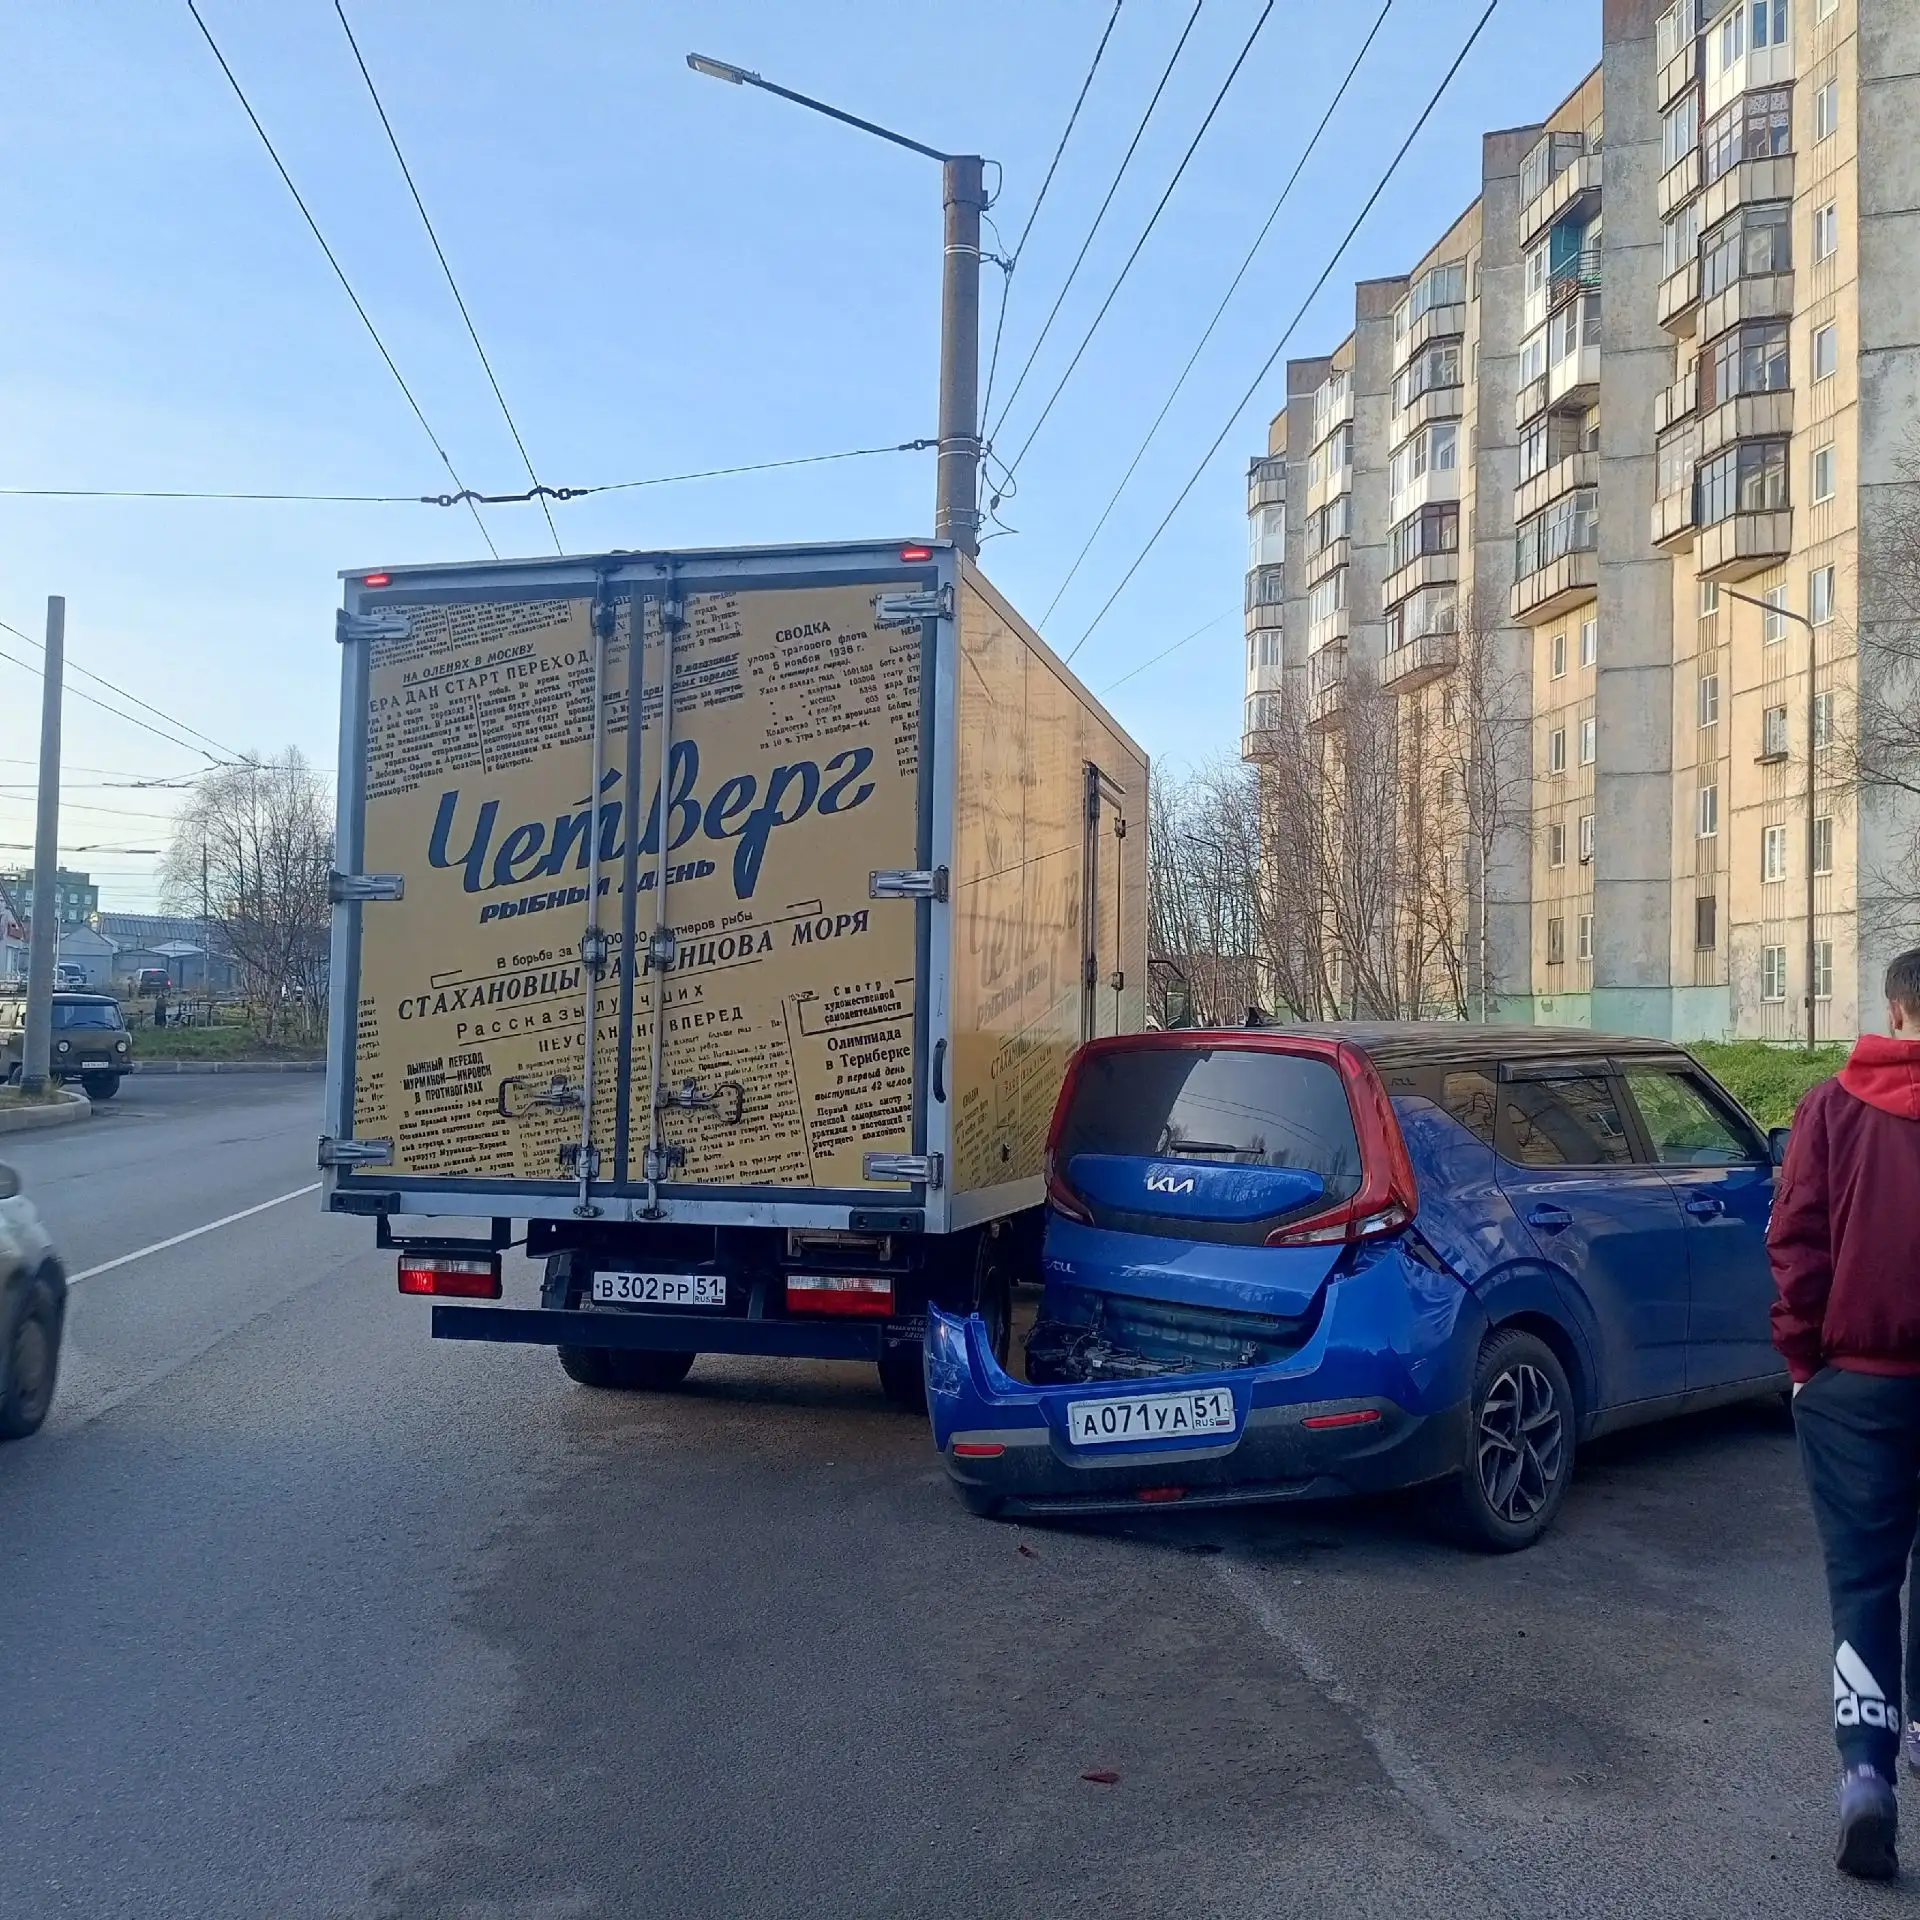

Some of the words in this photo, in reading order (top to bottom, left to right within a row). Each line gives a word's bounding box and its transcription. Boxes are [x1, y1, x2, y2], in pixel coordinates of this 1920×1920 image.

[775, 621, 831, 643] СВОДКА
[423, 659, 470, 678] ОЛЕНЯХ
[487, 642, 534, 664] МОСКВУ
[747, 652, 776, 667] улова
[838, 631, 868, 646] флота
[784, 653, 820, 669] ноября
[405, 685, 439, 705] ДАН
[445, 671, 499, 694] СТАРТ
[506, 650, 593, 680] ПЕРЕХОД
[428, 738, 876, 900] Четверг
[479, 877, 610, 924] РЫБНЫЙ
[617, 859, 716, 894] ДЕНЬ
[512, 951, 553, 967] борьбе
[667, 918, 716, 937] нтнеров
[721, 911, 754, 929] рыбы
[398, 966, 580, 1021] СТАХАНОВЦЫ
[791, 909, 870, 947] МОРЯ
[824, 988, 896, 1012] художественной
[824, 1001, 902, 1024] самодеятельности
[456, 1005, 585, 1039] Рассказы
[539, 1020, 656, 1053] НЕУСАННО
[668, 1005, 744, 1033] ВПЕРЕД
[827, 1028, 902, 1052] Олимпиада
[407, 1057, 444, 1076] ЛЫЖНЫЙ
[448, 1052, 484, 1069] ПЕРЕХОД
[885, 1066, 905, 1076] день
[425, 1081, 484, 1101] ПРОТИВОГАЗАХ
[1146, 1176, 1195, 1194] KIA
[602, 1276, 690, 1301] В302РР
[696, 1277, 719, 1296] 51
[694, 1295, 711, 1303] RUS
[1083, 1403, 1188, 1436] А071УА
[1194, 1395, 1222, 1418] 51
[1195, 1418, 1215, 1428] RUS
[1834, 1691, 1900, 1735] das
